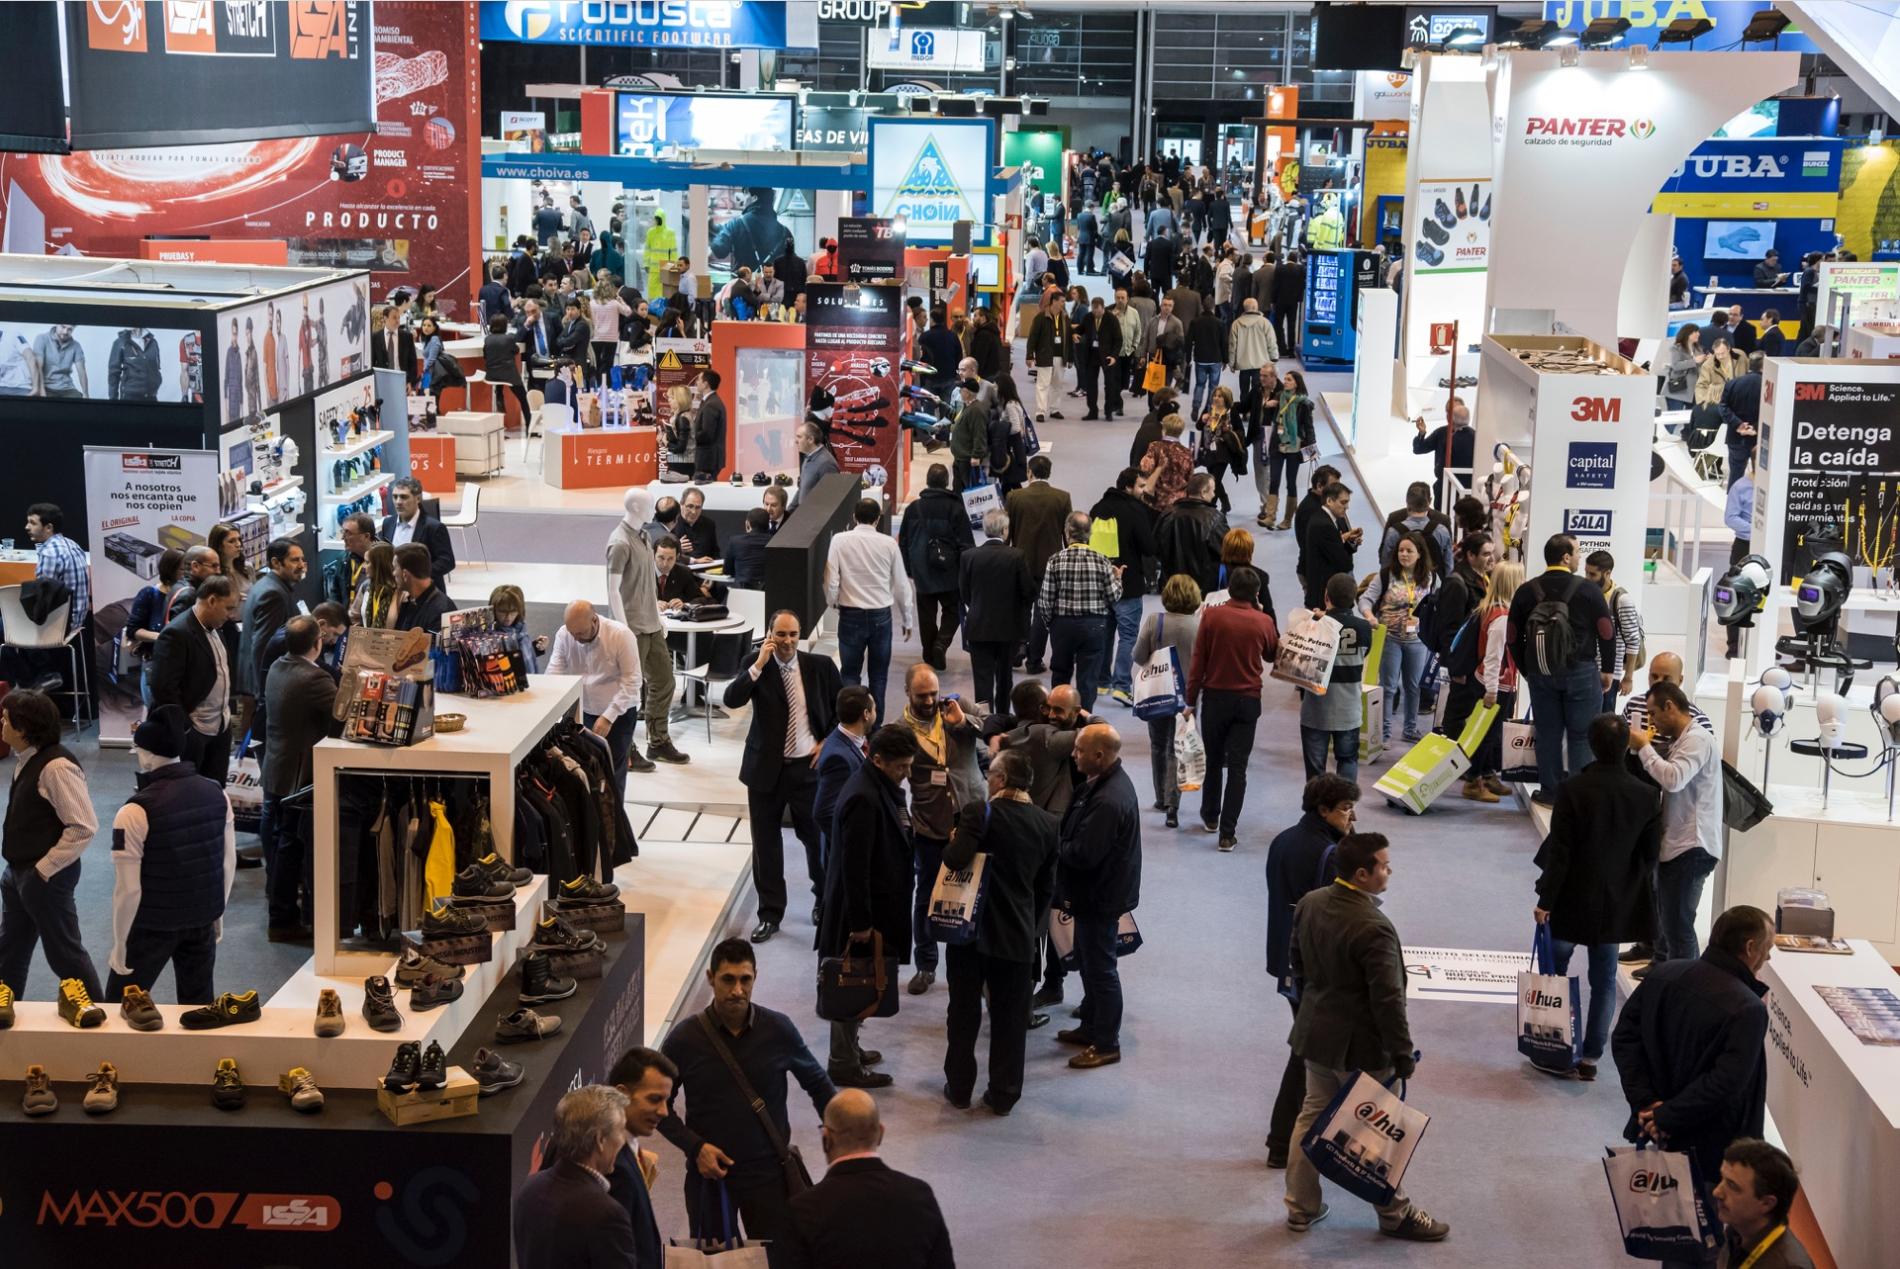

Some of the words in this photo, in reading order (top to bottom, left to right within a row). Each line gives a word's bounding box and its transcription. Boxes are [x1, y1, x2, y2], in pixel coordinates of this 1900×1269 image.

[817, 1, 889, 21] GROUP
[559, 27, 644, 43] SCIENTIFIC
[652, 30, 732, 46] FOOTWEAR
[1525, 117, 1626, 138] PANTER
[826, 130, 846, 145] DE
[850, 132, 869, 146] VI
[1558, 138, 1569, 146] de
[1570, 138, 1612, 148] seguridad
[374, 150, 405, 159] PRODUCT
[374, 158, 407, 168] MANAGER
[1670, 154, 1786, 178] JUBA
[496, 167, 590, 180] www.choiva.es
[305, 211, 439, 230] PRODUCTO
[1455, 246, 1487, 256] PANTER
[1794, 383, 1825, 401] 3M
[1828, 384, 1864, 393] Science.
[1828, 393, 1861, 402] Applied
[1570, 396, 1621, 422] 3M
[1796, 421, 1892, 445] Detenga
[1569, 454, 1614, 471] capital
[1794, 446, 1813, 465] la
[1818, 447, 1879, 466] caída
[125, 481, 133, 491] A
[135, 482, 182, 492] nosotros
[111, 492, 130, 500] nos
[131, 493, 174, 501] encanta
[176, 494, 197, 504] que
[1790, 489, 1824, 500] conta
[126, 502, 145, 510] nos
[147, 502, 183, 513] copien
[110, 515, 140, 528] ORIGINAL
[179, 515, 196, 523] COPIA
[1570, 514, 1606, 530] SALA
[1579, 540, 1611, 548] PYTHON
[36, 1189, 217, 1228] MAX500
